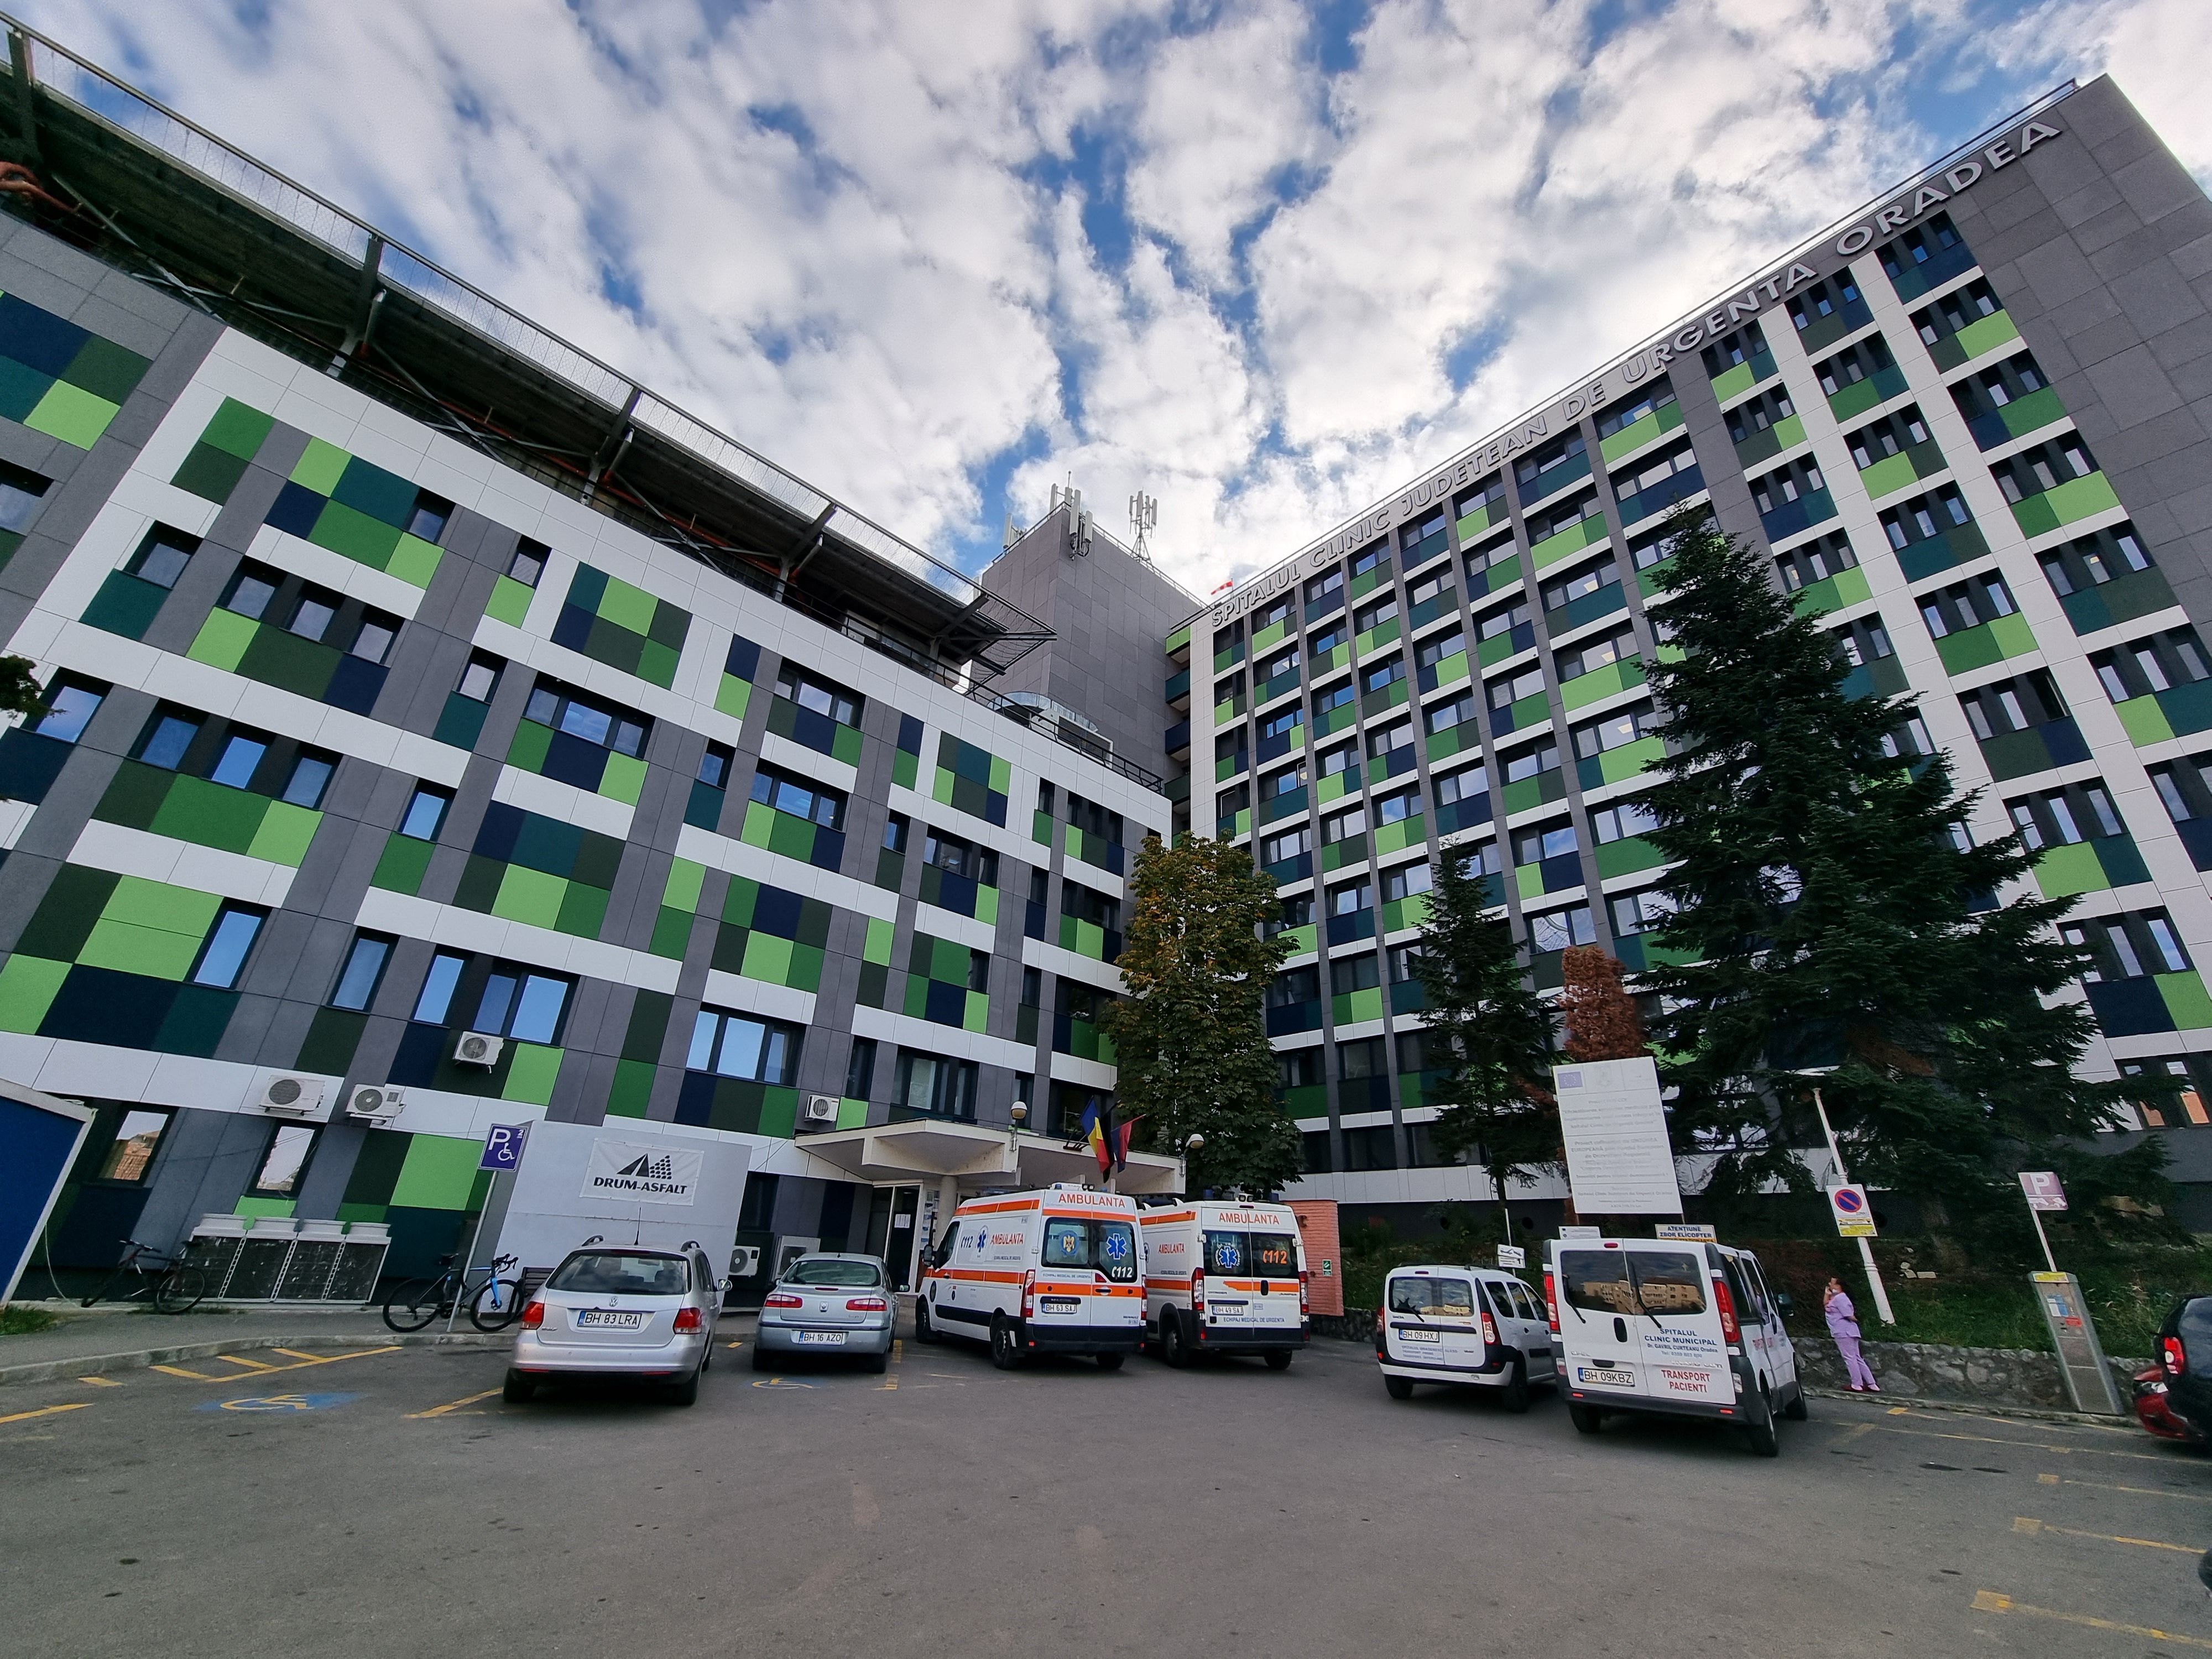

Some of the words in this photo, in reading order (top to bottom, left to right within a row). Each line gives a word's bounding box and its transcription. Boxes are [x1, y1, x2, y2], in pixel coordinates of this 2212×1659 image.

[1212, 564, 1301, 627] SPITALUL
[1310, 509, 1390, 568] CLINIC
[1402, 415, 1548, 516] JUDETEAN
[1562, 381, 1606, 421] DE
[1621, 262, 1818, 383] URGENTA
[1836, 120, 2063, 256] ORADEA
[488, 1128, 511, 1150] P
[593, 1177, 687, 1194] DRUM-ASFALT
[2030, 1173, 2050, 1194] P
[1058, 1193, 1125, 1208] AMBULANTA
[1219, 1212, 1280, 1225] AMBULANTA
[990, 1233, 1024, 1244] AMBULANTA
[1158, 1244, 1185, 1254] AMBULANTA
[585, 1313, 601, 1323] BH
[604, 1314, 617, 1324] 83
[618, 1315, 637, 1325] LRA
[804, 1333, 815, 1342] BH
[826, 1334, 841, 1342] AZO
[1673, 1337, 1717, 1345] MUNICIPAL
[1584, 1371, 1598, 1380] BH
[1661, 1369, 1710, 1382] TRANSPORT
[1669, 1381, 1707, 1392] PACIENTI
